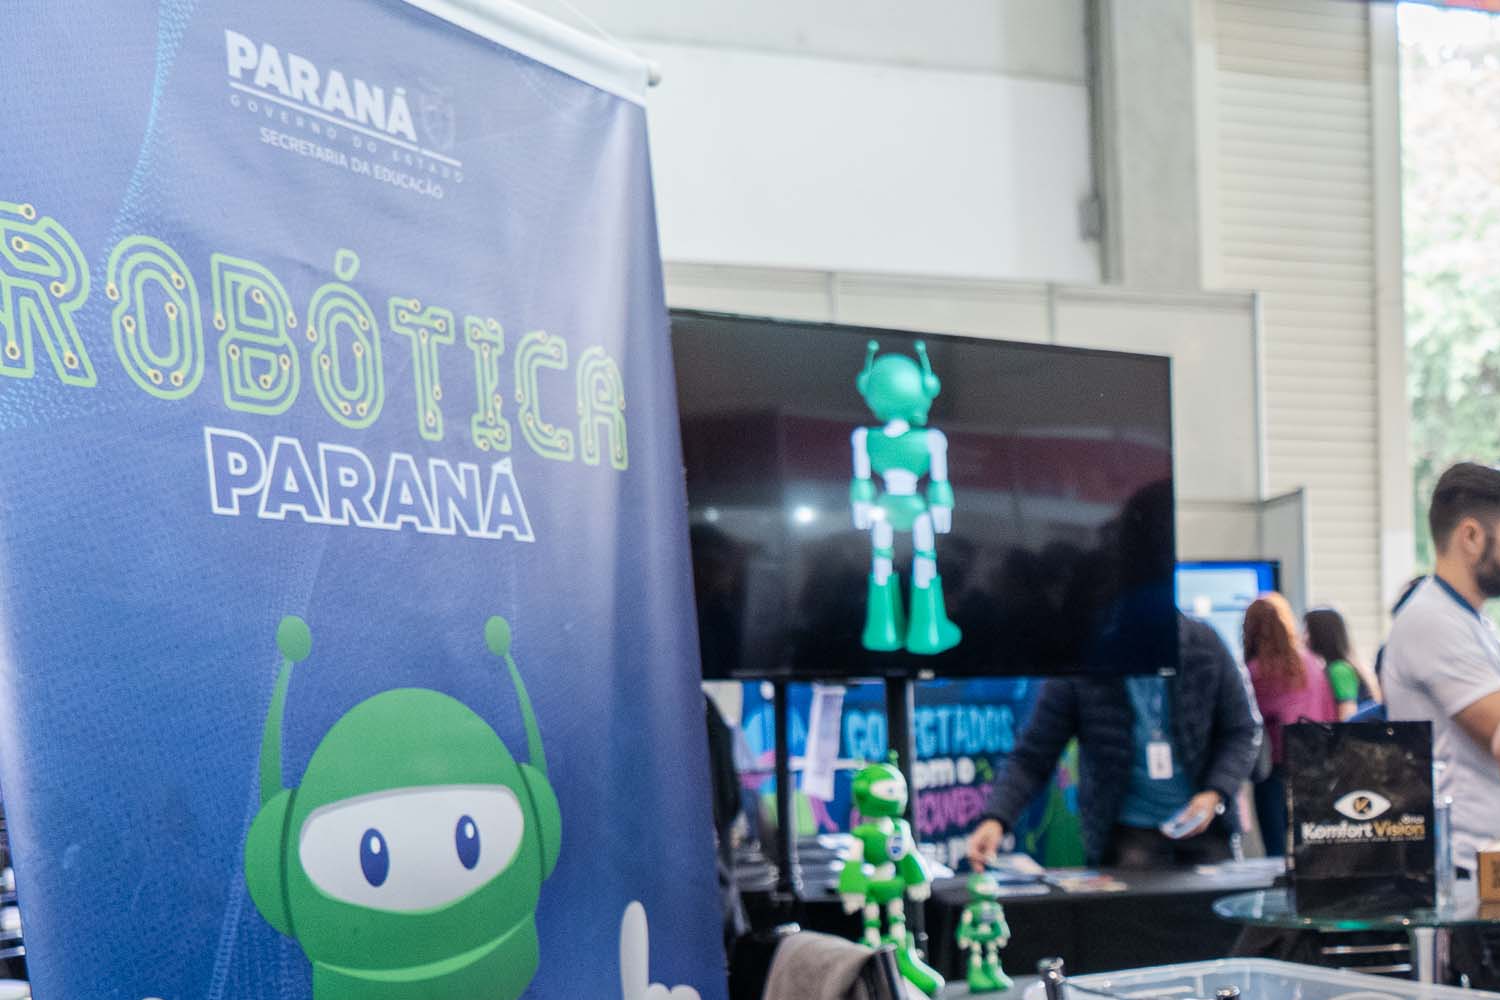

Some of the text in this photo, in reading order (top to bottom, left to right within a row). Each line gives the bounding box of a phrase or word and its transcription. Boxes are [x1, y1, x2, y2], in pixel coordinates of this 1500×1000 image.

[224, 29, 417, 142] PARANÁ
[230, 94, 337, 139] GOVERNO
[352, 136, 376, 152] DO
[259, 127, 444, 199] SECRETARIA DA EDUCAÇÃO
[0, 202, 628, 470] ROBÓTICA
[204, 426, 535, 542] PARANÁ
[1373, 820, 1425, 837] Vision
